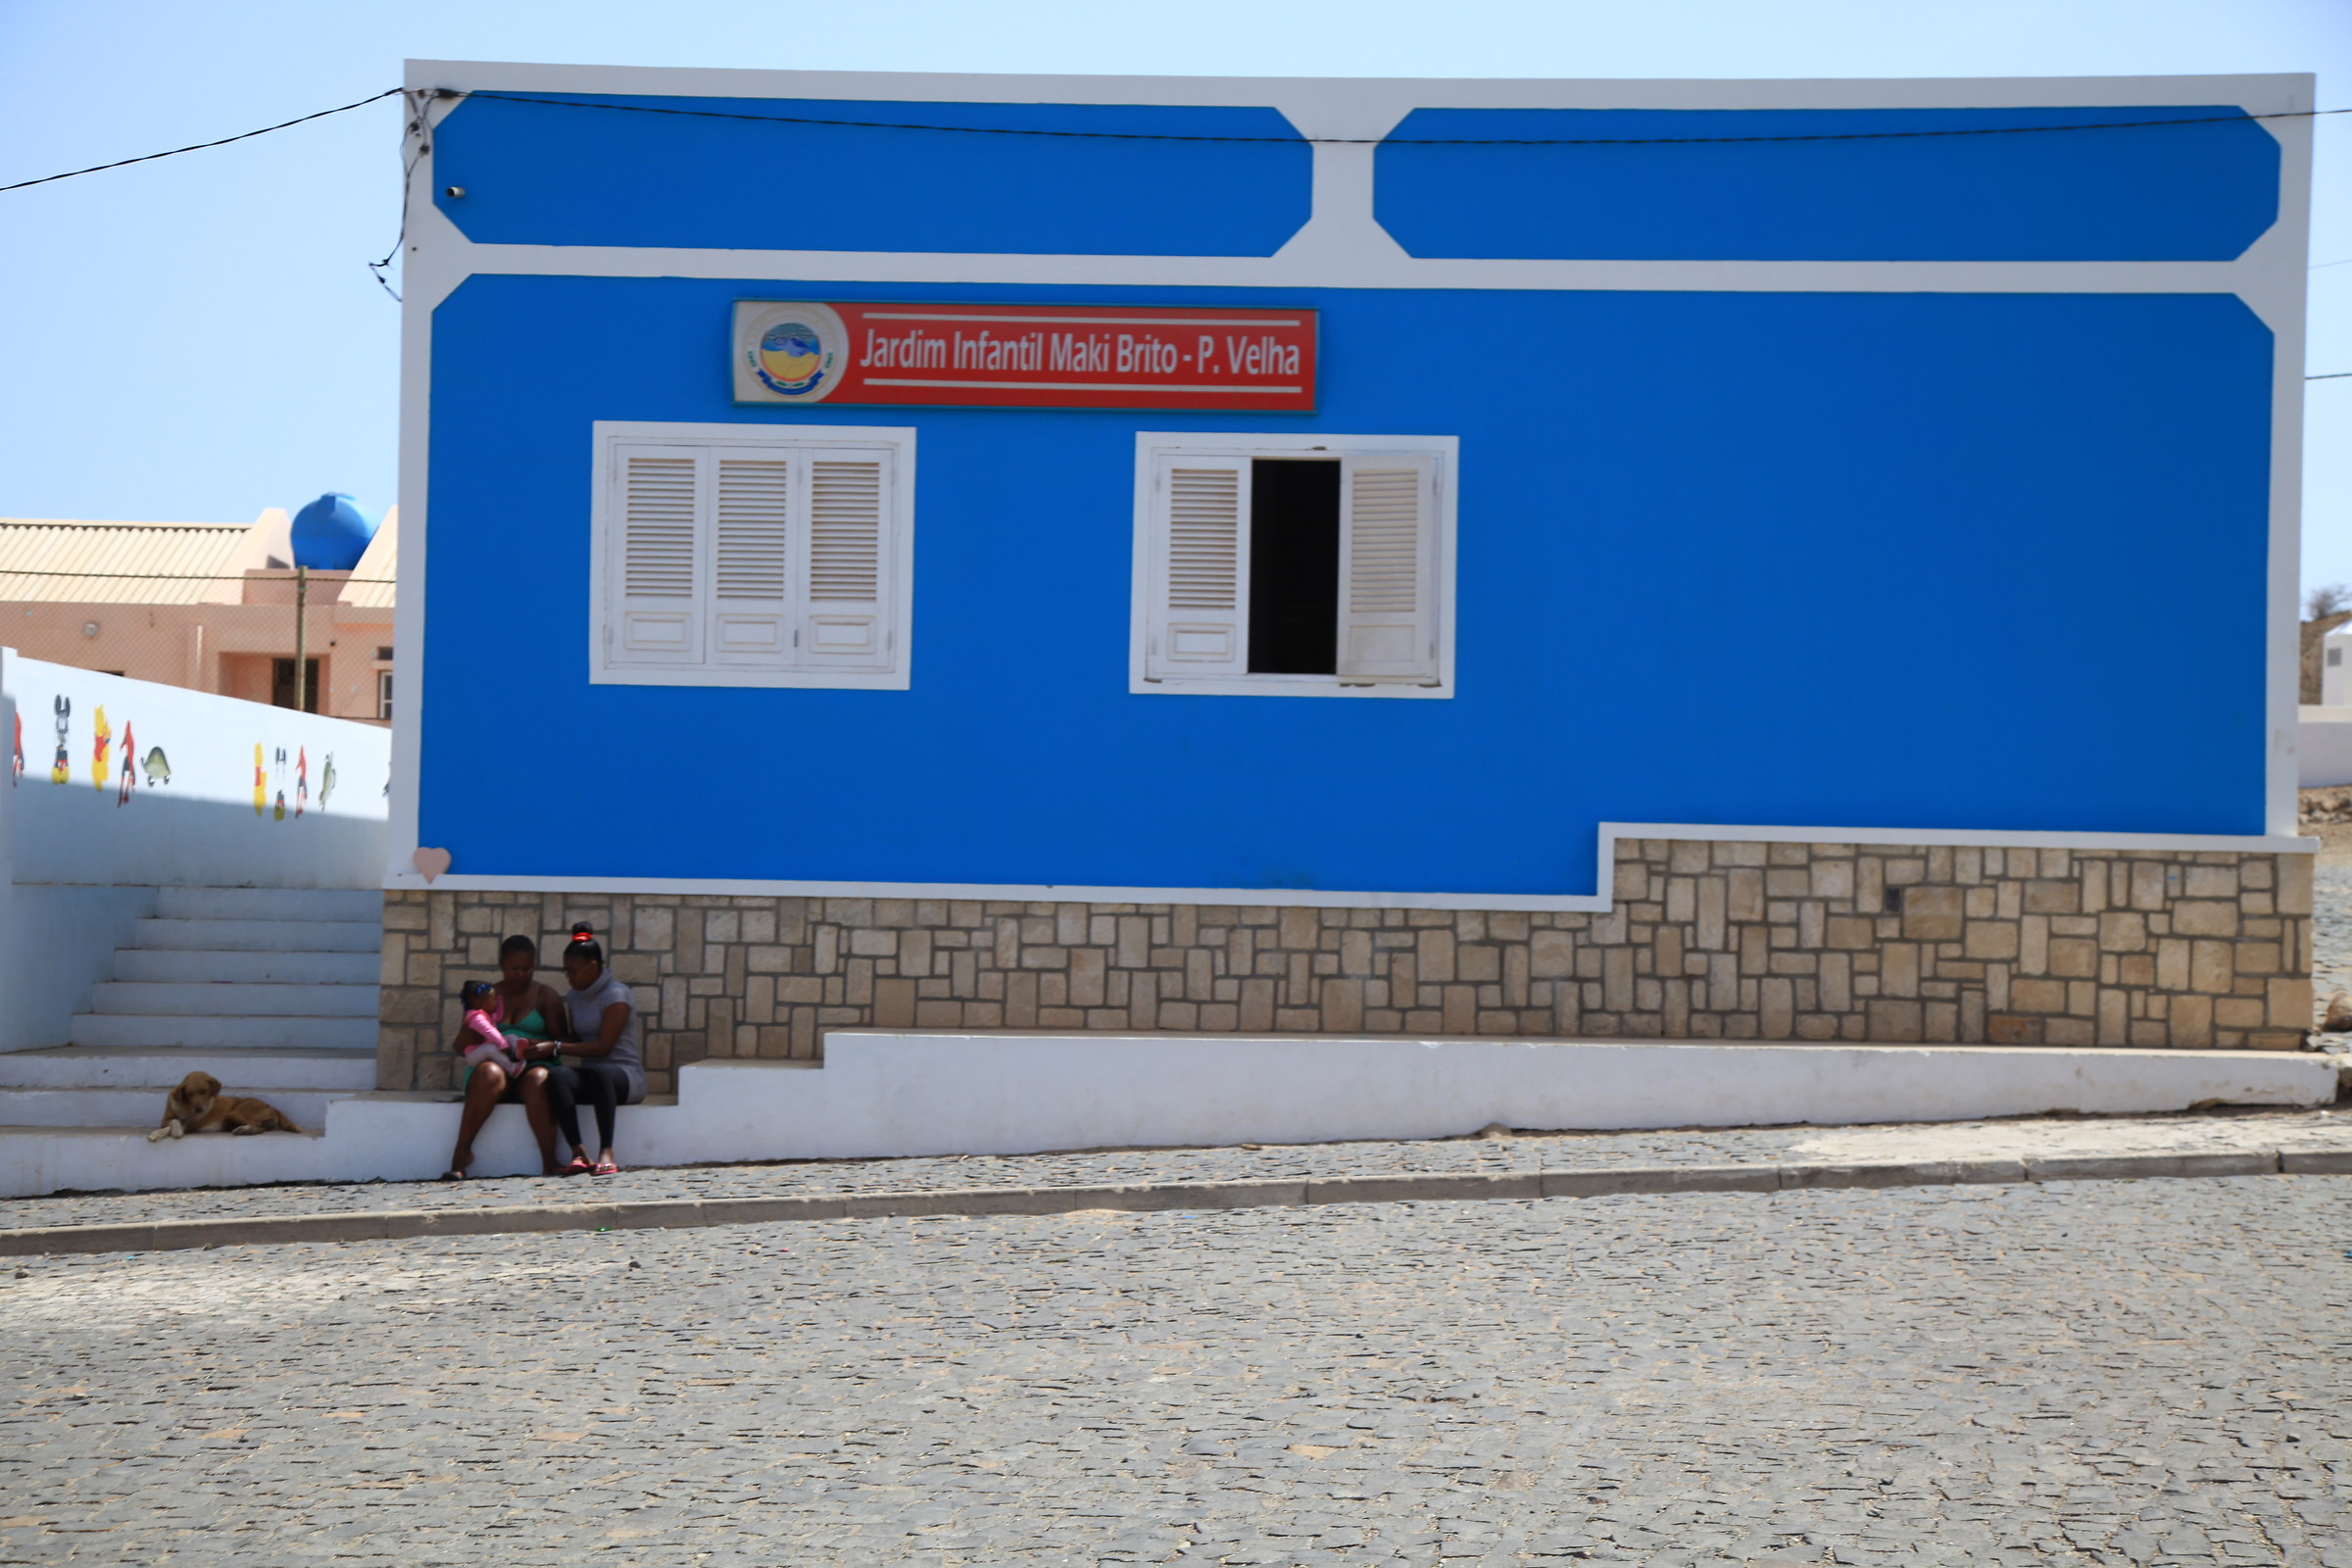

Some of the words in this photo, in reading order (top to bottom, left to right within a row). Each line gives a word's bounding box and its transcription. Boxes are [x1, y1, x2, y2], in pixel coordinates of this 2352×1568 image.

[859, 328, 947, 368] Jardim
[953, 329, 1045, 371] Infantil
[1049, 332, 1110, 372] Maki
[1116, 333, 1178, 374] Brito
[1198, 335, 1220, 374] P.
[1226, 335, 1300, 375] Velha
